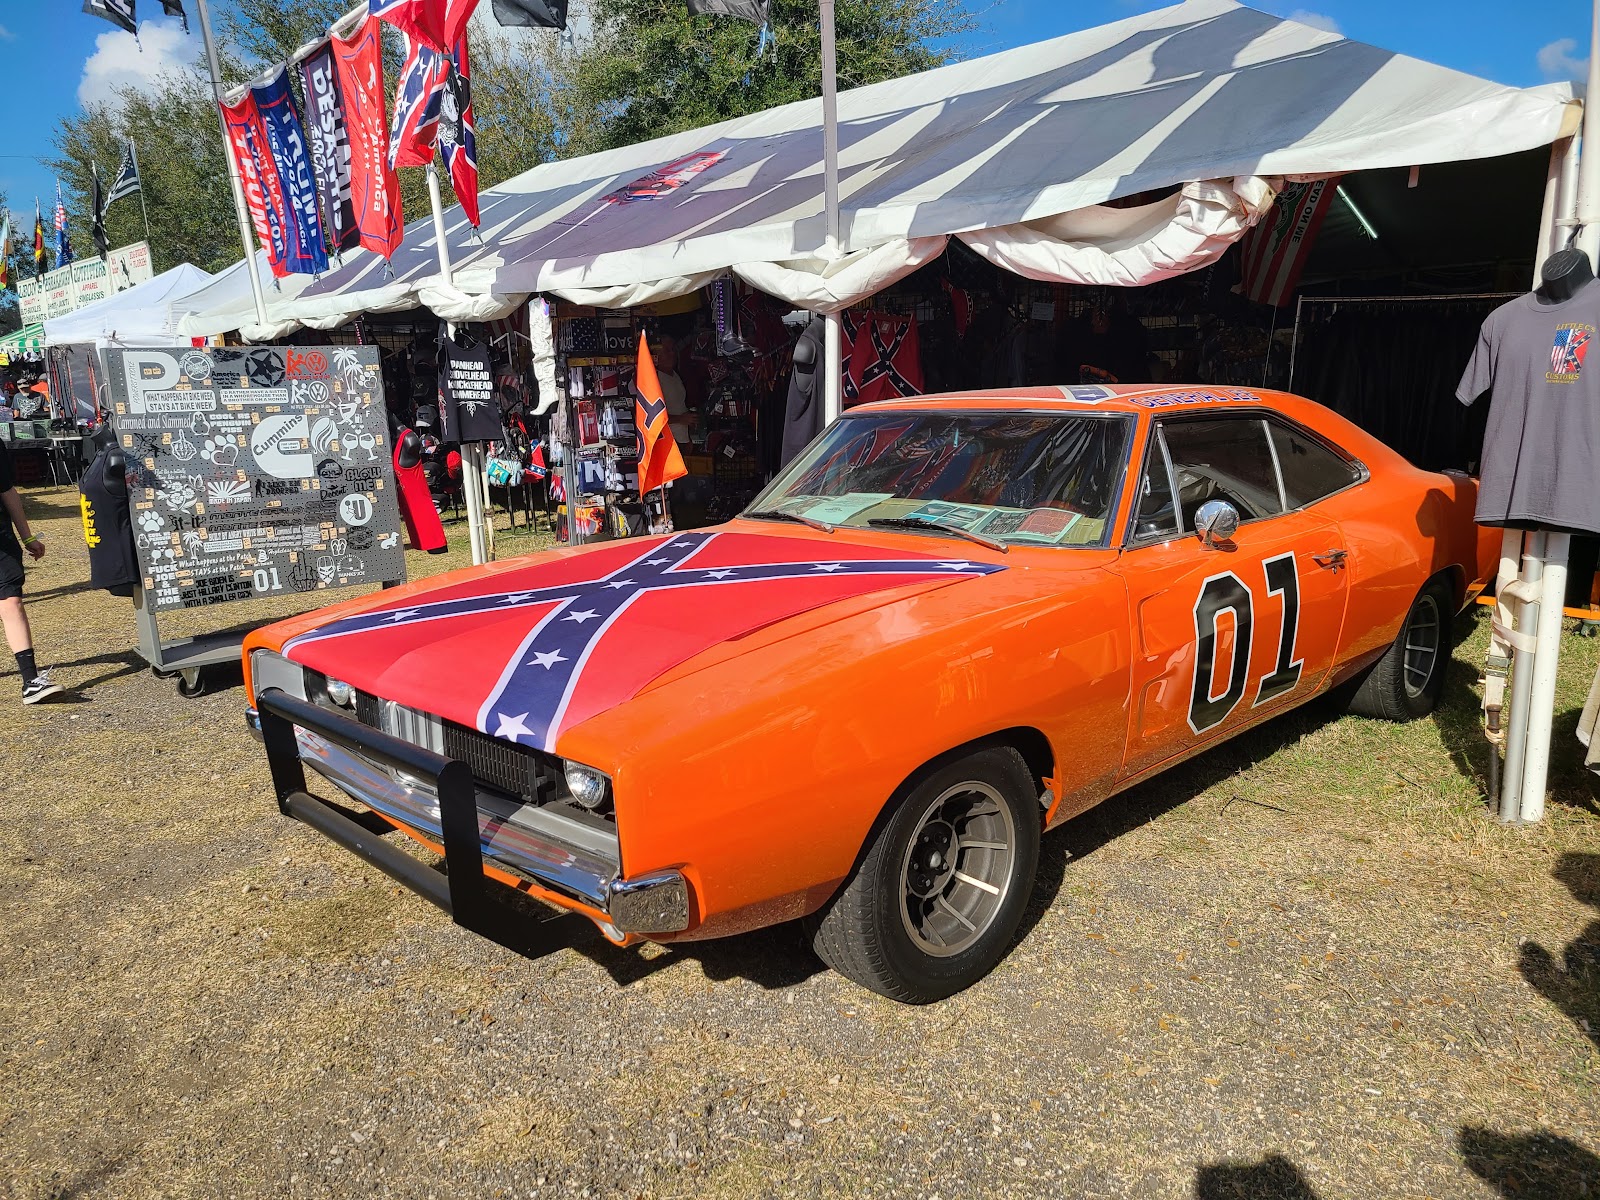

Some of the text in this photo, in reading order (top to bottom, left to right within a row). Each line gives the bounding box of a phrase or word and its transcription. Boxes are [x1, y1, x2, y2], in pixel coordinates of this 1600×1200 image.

[1555, 322, 1584, 331] LITTLE
[450, 359, 484, 371] PANHEAD
[146, 391, 214, 402] WHAT HAPPENS AT BIKE WEEK
[1128, 389, 1231, 409] GENERAL
[149, 402, 214, 411] STAYS AT BIKE WEEK
[116, 413, 147, 430] Cammed
[147, 413, 161, 429] and
[252, 414, 304, 457] Cummins
[345, 466, 382, 481] BLOW
[353, 478, 375, 492] ME
[179, 559, 196, 568] What
[196, 556, 219, 568] happens
[226, 553, 236, 561] the
[148, 563, 179, 575] FUCK
[190, 568, 211, 577] STAYS
[219, 565, 229, 574] the
[229, 562, 246, 572] Patch
[155, 572, 176, 582] JOE
[195, 578, 209, 588] JOE
[254, 567, 284, 592] 01
[161, 580, 171, 589] &
[155, 587, 179, 597] THE
[182, 590, 198, 600] JUST
[156, 595, 181, 606] HOE
[183, 598, 201, 609] WITH
[1187, 550, 1304, 736] 01
